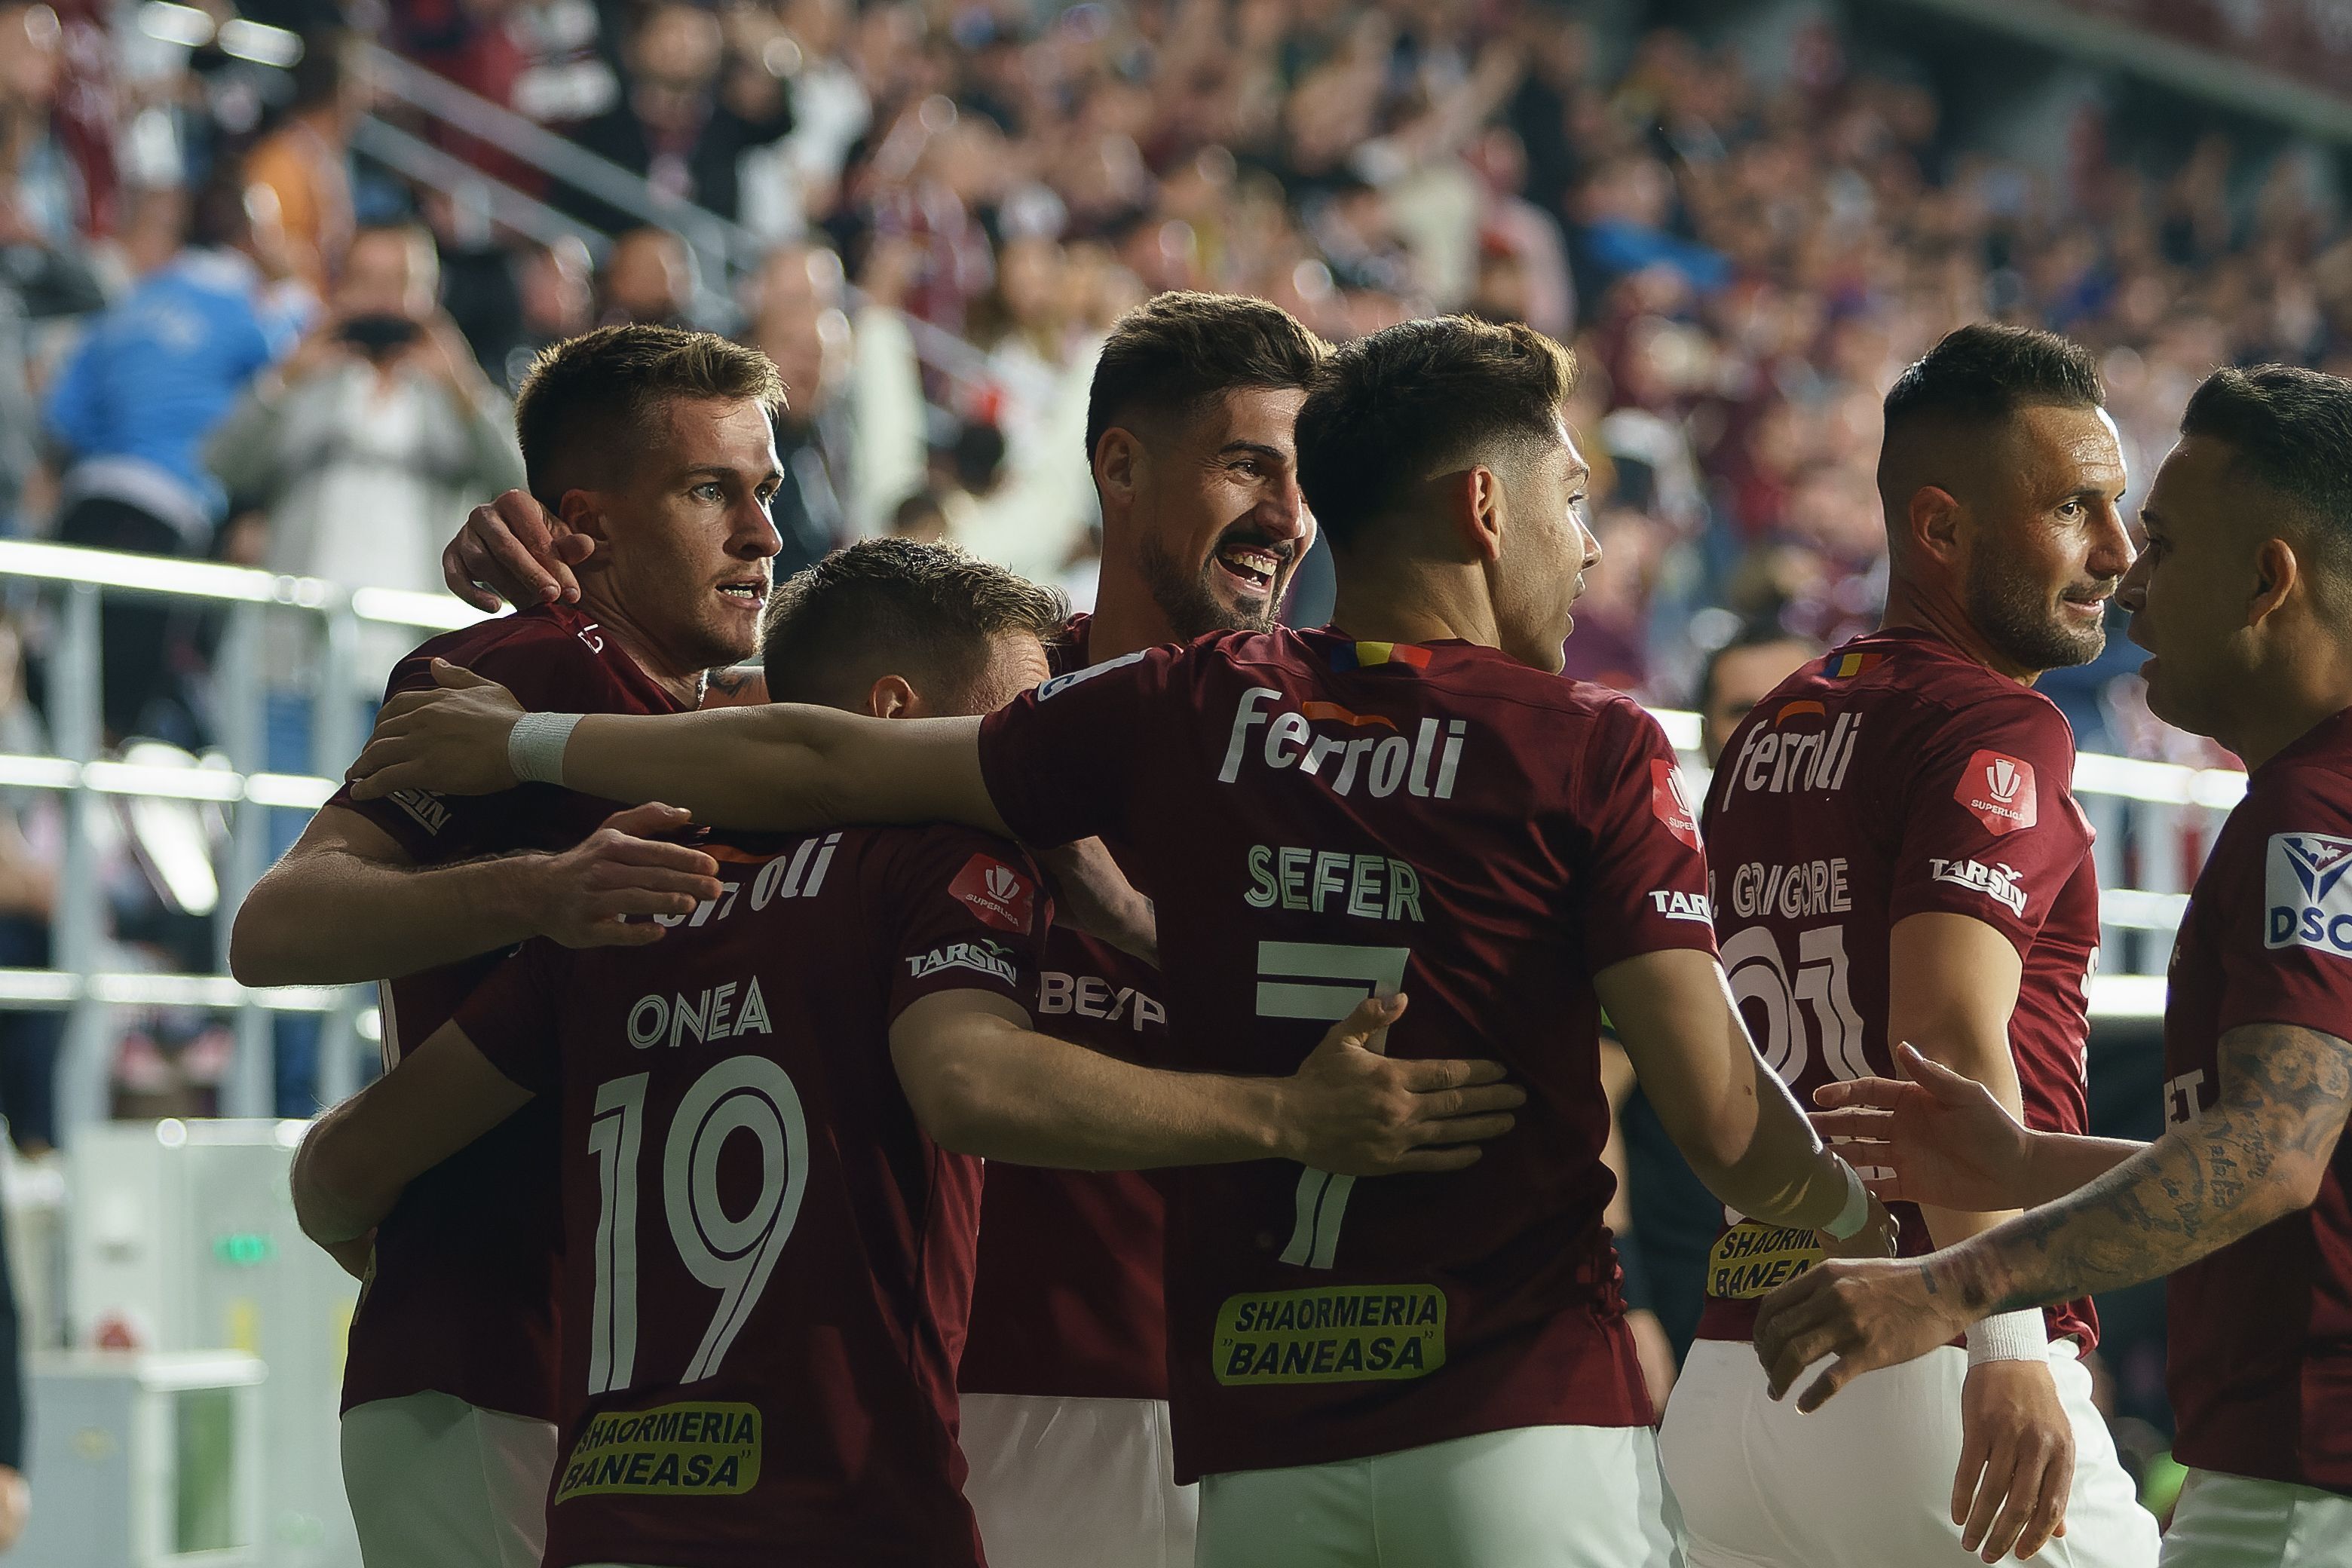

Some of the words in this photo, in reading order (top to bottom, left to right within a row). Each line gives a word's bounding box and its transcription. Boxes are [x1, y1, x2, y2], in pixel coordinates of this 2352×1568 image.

[966, 893, 1020, 927] SUPERLIGA
[1244, 844, 1425, 922] SEFER
[1929, 859, 2028, 919] TARSIN
[905, 942, 1017, 988] TARSIN
[626, 975, 773, 1049] ONEA
[1256, 941, 1410, 1269] 7
[587, 1055, 809, 1396] 19
[1720, 1228, 1822, 1260] SHAORM
[1235, 1295, 1438, 1333] SHAORMERIA
